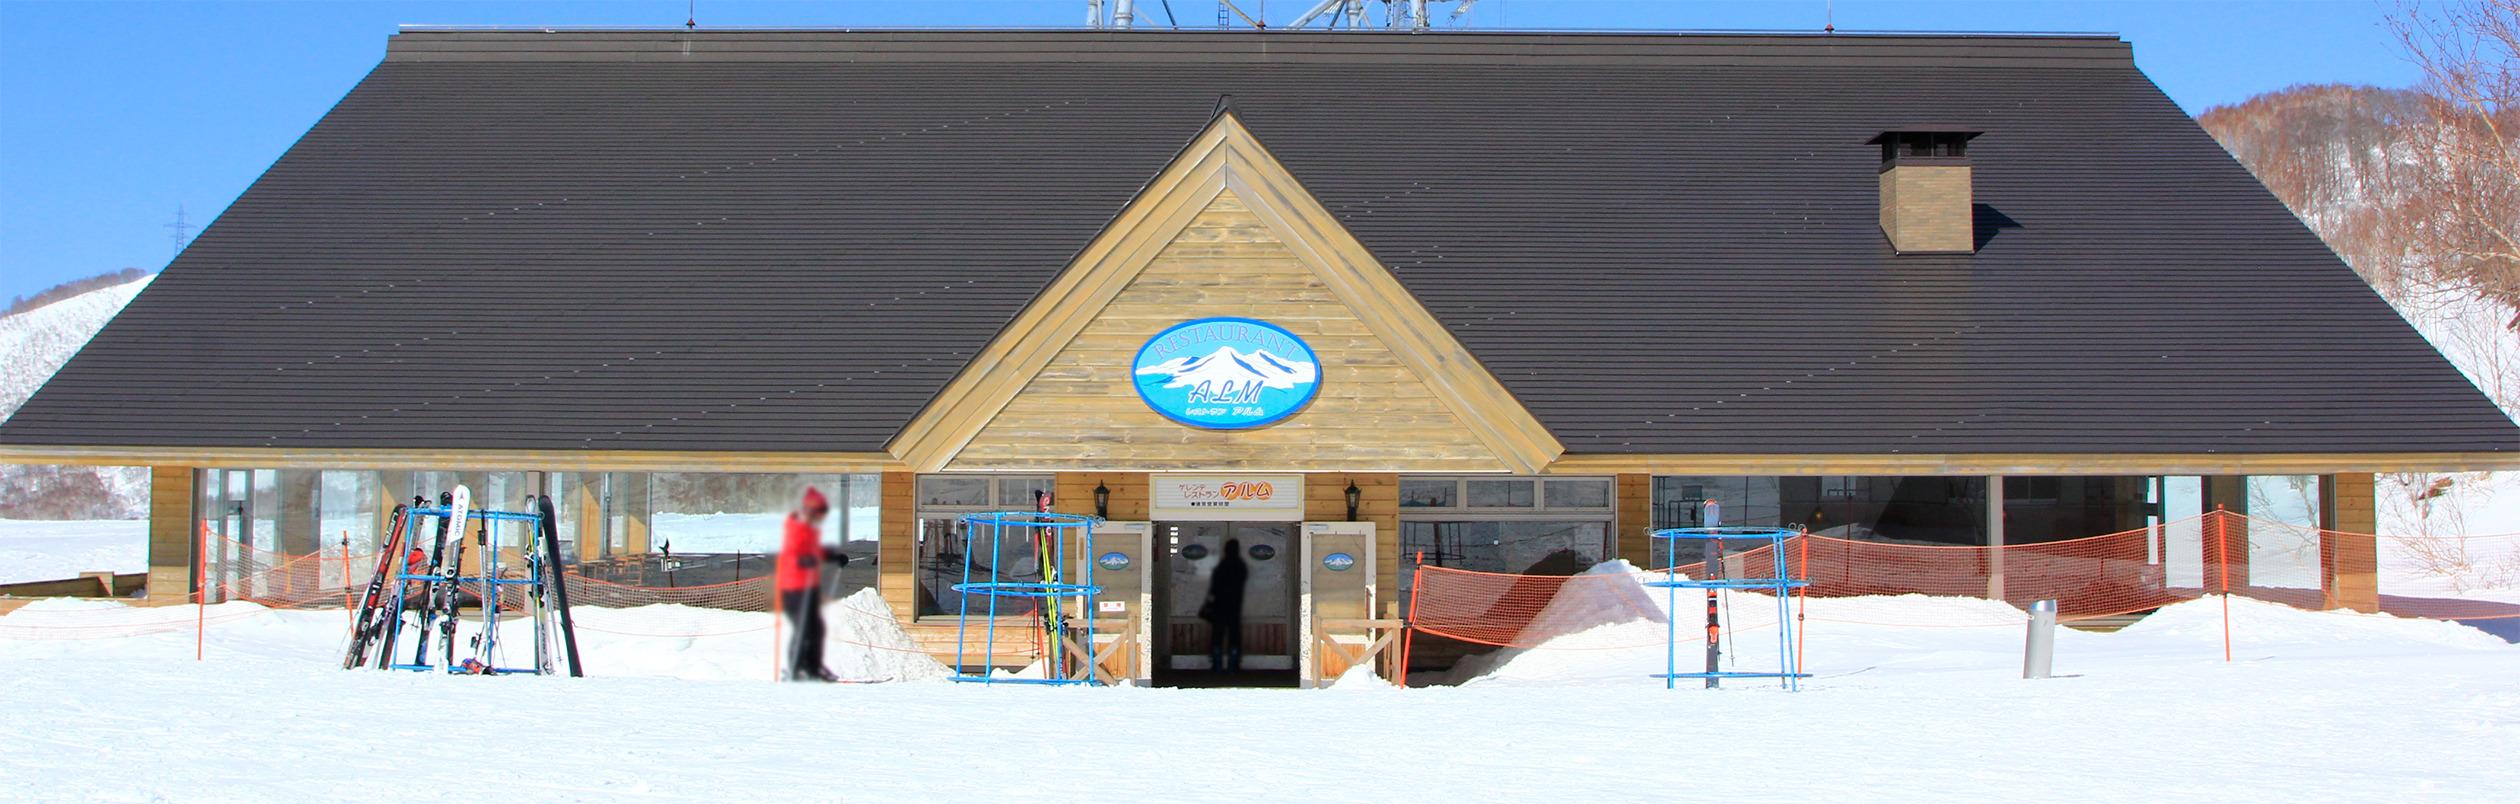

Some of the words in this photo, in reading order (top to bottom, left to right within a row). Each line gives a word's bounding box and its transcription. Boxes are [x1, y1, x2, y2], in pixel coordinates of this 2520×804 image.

[1153, 324, 1302, 360] RESTAURANT
[1188, 379, 1265, 404] ALM
[1184, 490, 1220, 499] レストラン
[1222, 482, 1271, 499] アルム
[454, 503, 464, 537] ATOMIC
